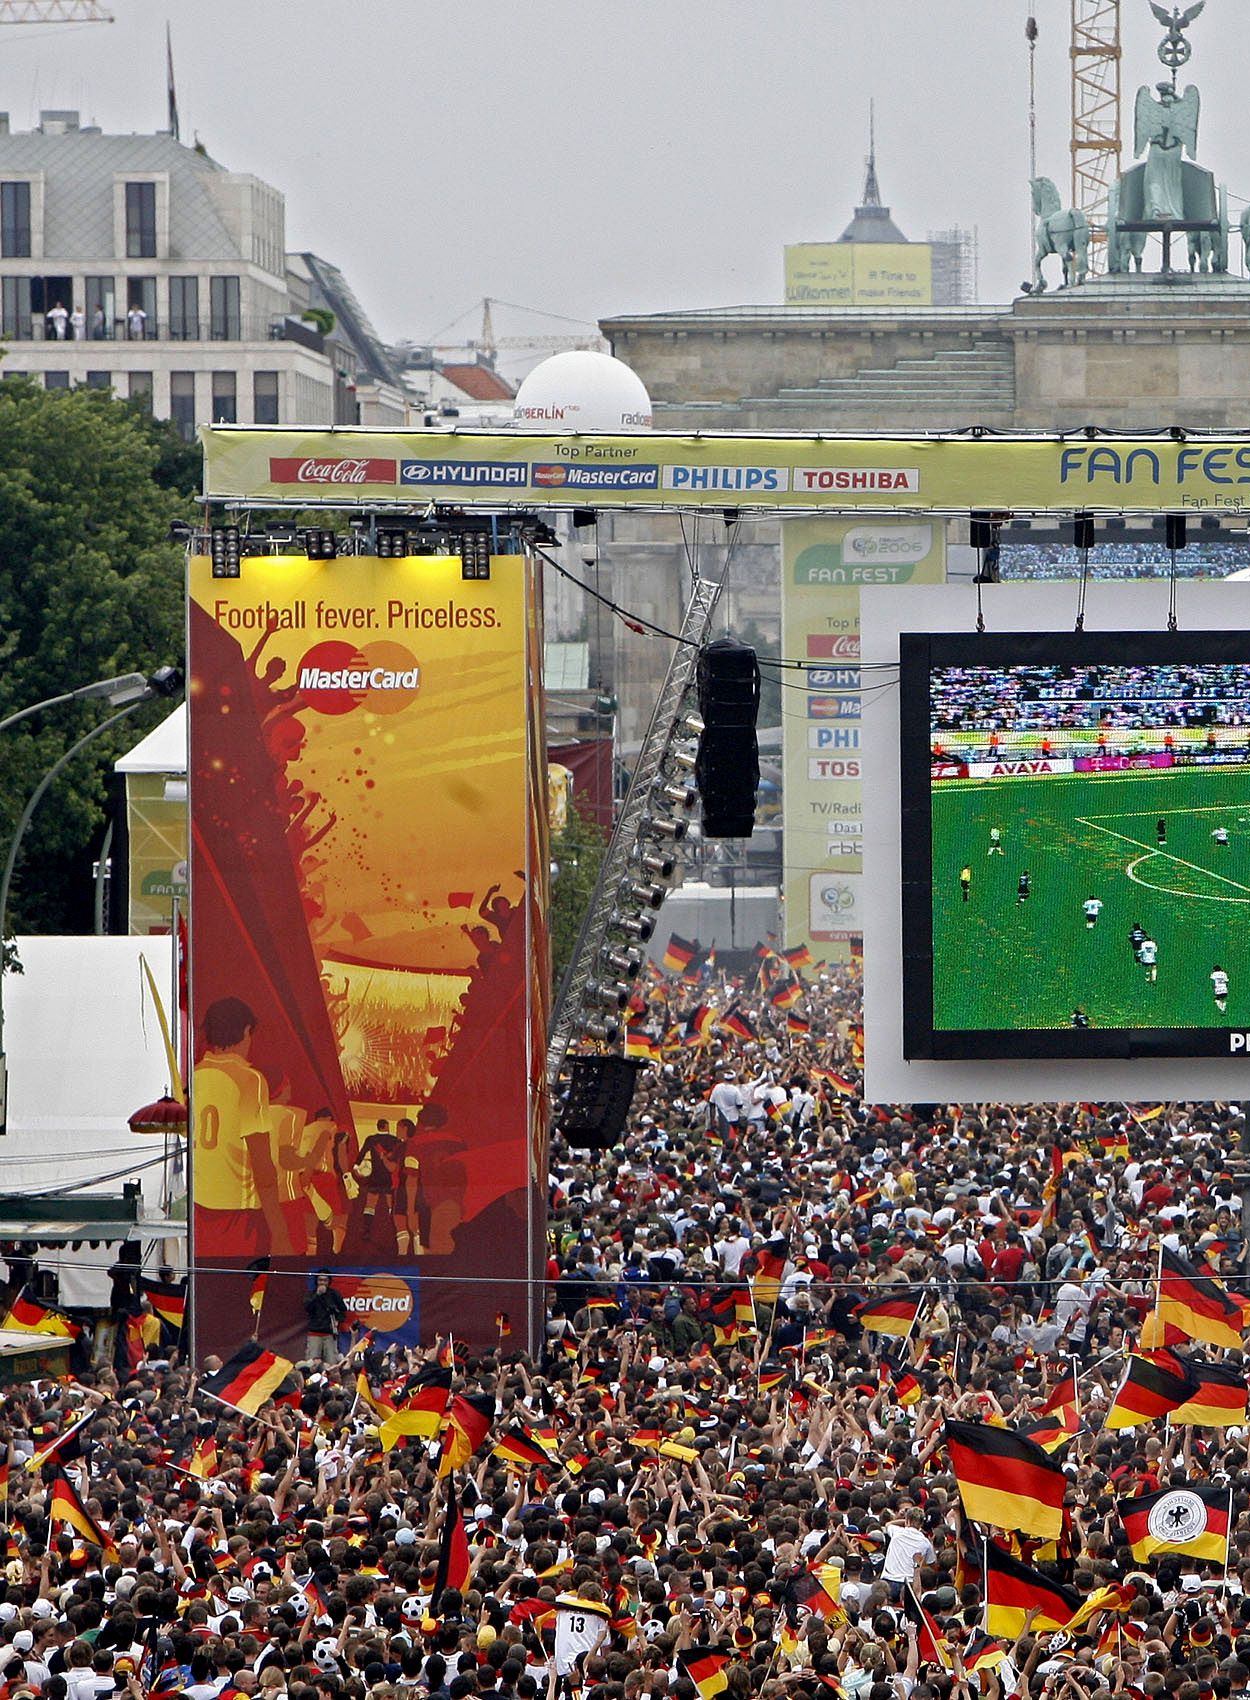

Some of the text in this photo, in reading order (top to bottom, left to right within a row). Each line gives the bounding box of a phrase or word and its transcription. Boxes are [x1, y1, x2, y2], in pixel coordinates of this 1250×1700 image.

[554, 444, 638, 459] Top Partner
[433, 466, 526, 482] HYUNDAI
[1060, 447, 1160, 485] FAN
[567, 468, 656, 486] MasterCard
[672, 467, 778, 490] PHILIPS
[802, 471, 910, 489] TOSHIBA
[1181, 493, 1209, 507] Fan
[1214, 493, 1247, 507] Fest
[807, 568, 900, 583] FAN FEST
[214, 600, 306, 630] Football
[315, 600, 380, 630] fever.
[387, 600, 502, 629] Priceless.
[825, 616, 850, 631] Top
[299, 667, 419, 690] MasterCard
[991, 761, 1053, 776] AVAYA
[570, 1615, 586, 1634] 13
